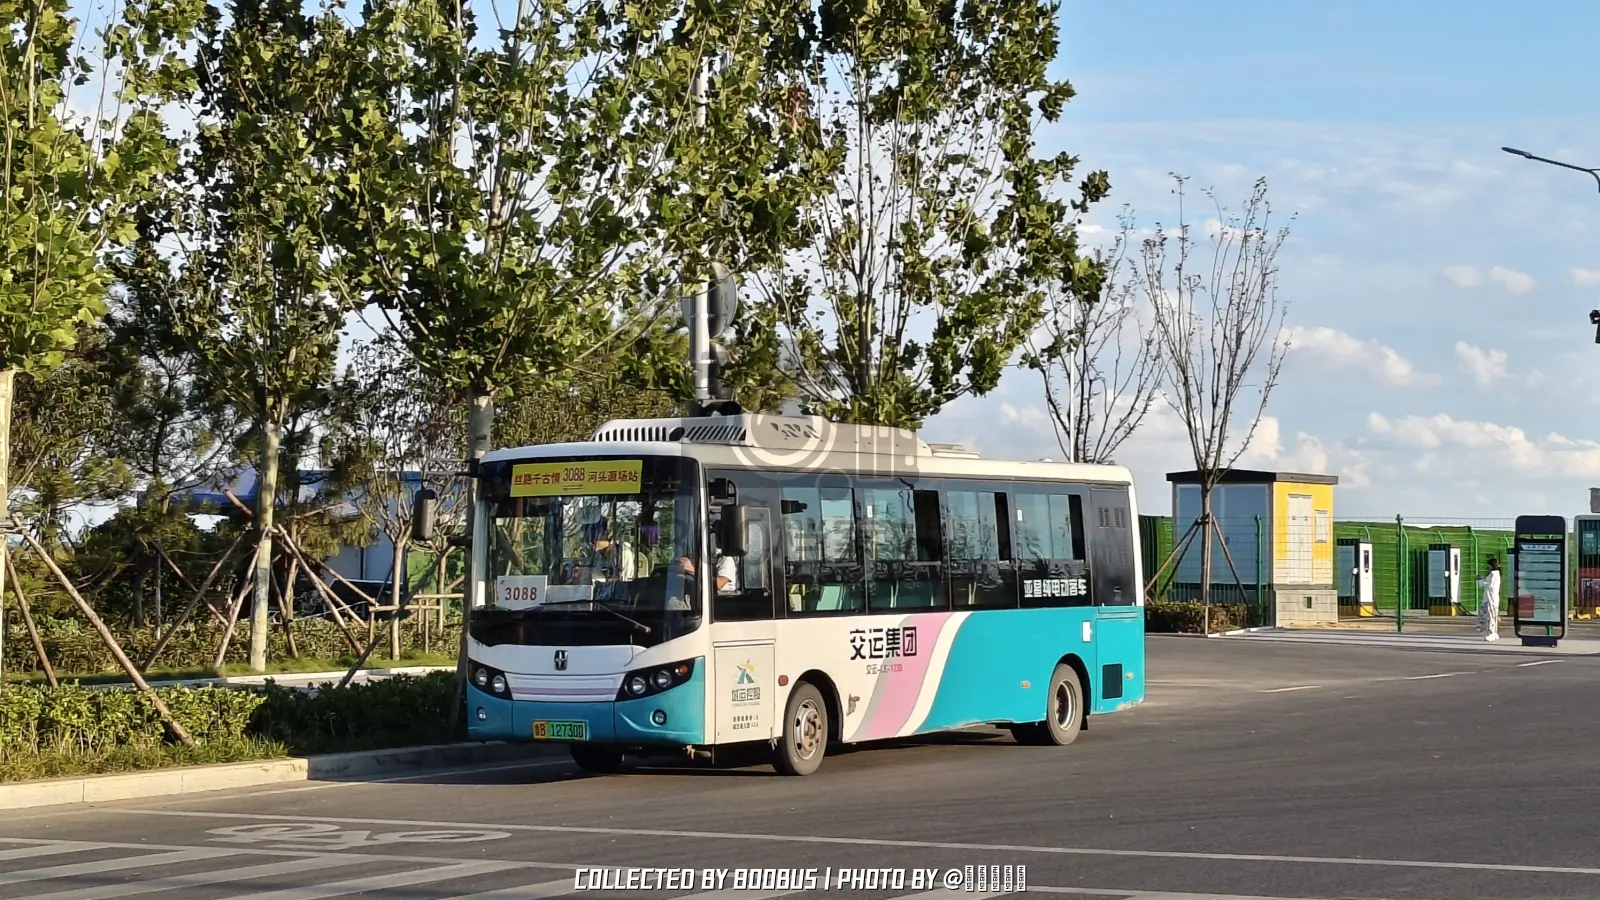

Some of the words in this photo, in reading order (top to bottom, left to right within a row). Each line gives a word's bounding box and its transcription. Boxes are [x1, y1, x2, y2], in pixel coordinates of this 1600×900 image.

[562, 467, 586, 482] 3088
[588, 470, 638, 483] 河头源场站
[504, 586, 538, 601] 3088
[1023, 578, 1087, 598] 亚星纯电动客车
[849, 626, 917, 661] 交运集团
